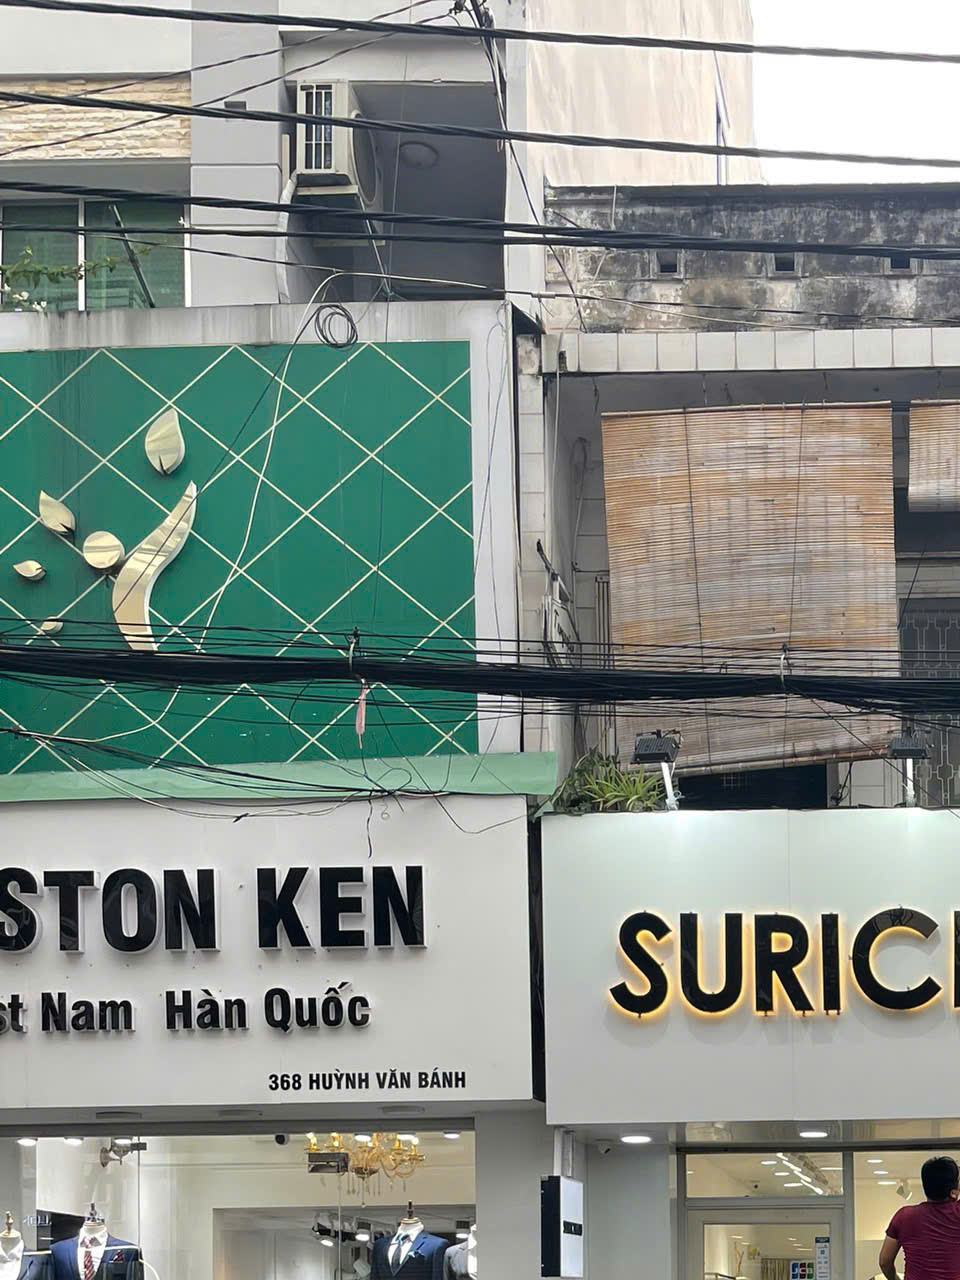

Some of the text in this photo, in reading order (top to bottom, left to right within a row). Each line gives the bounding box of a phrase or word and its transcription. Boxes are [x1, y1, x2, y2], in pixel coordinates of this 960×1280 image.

[256, 864, 426, 950] KEN
[41, 991, 135, 1032] Nam
[164, 988, 249, 1031] Hàn
[263, 982, 371, 1032] Quốc
[268, 1067, 466, 1091] 368 HUỲNH VĂN BÁNH
